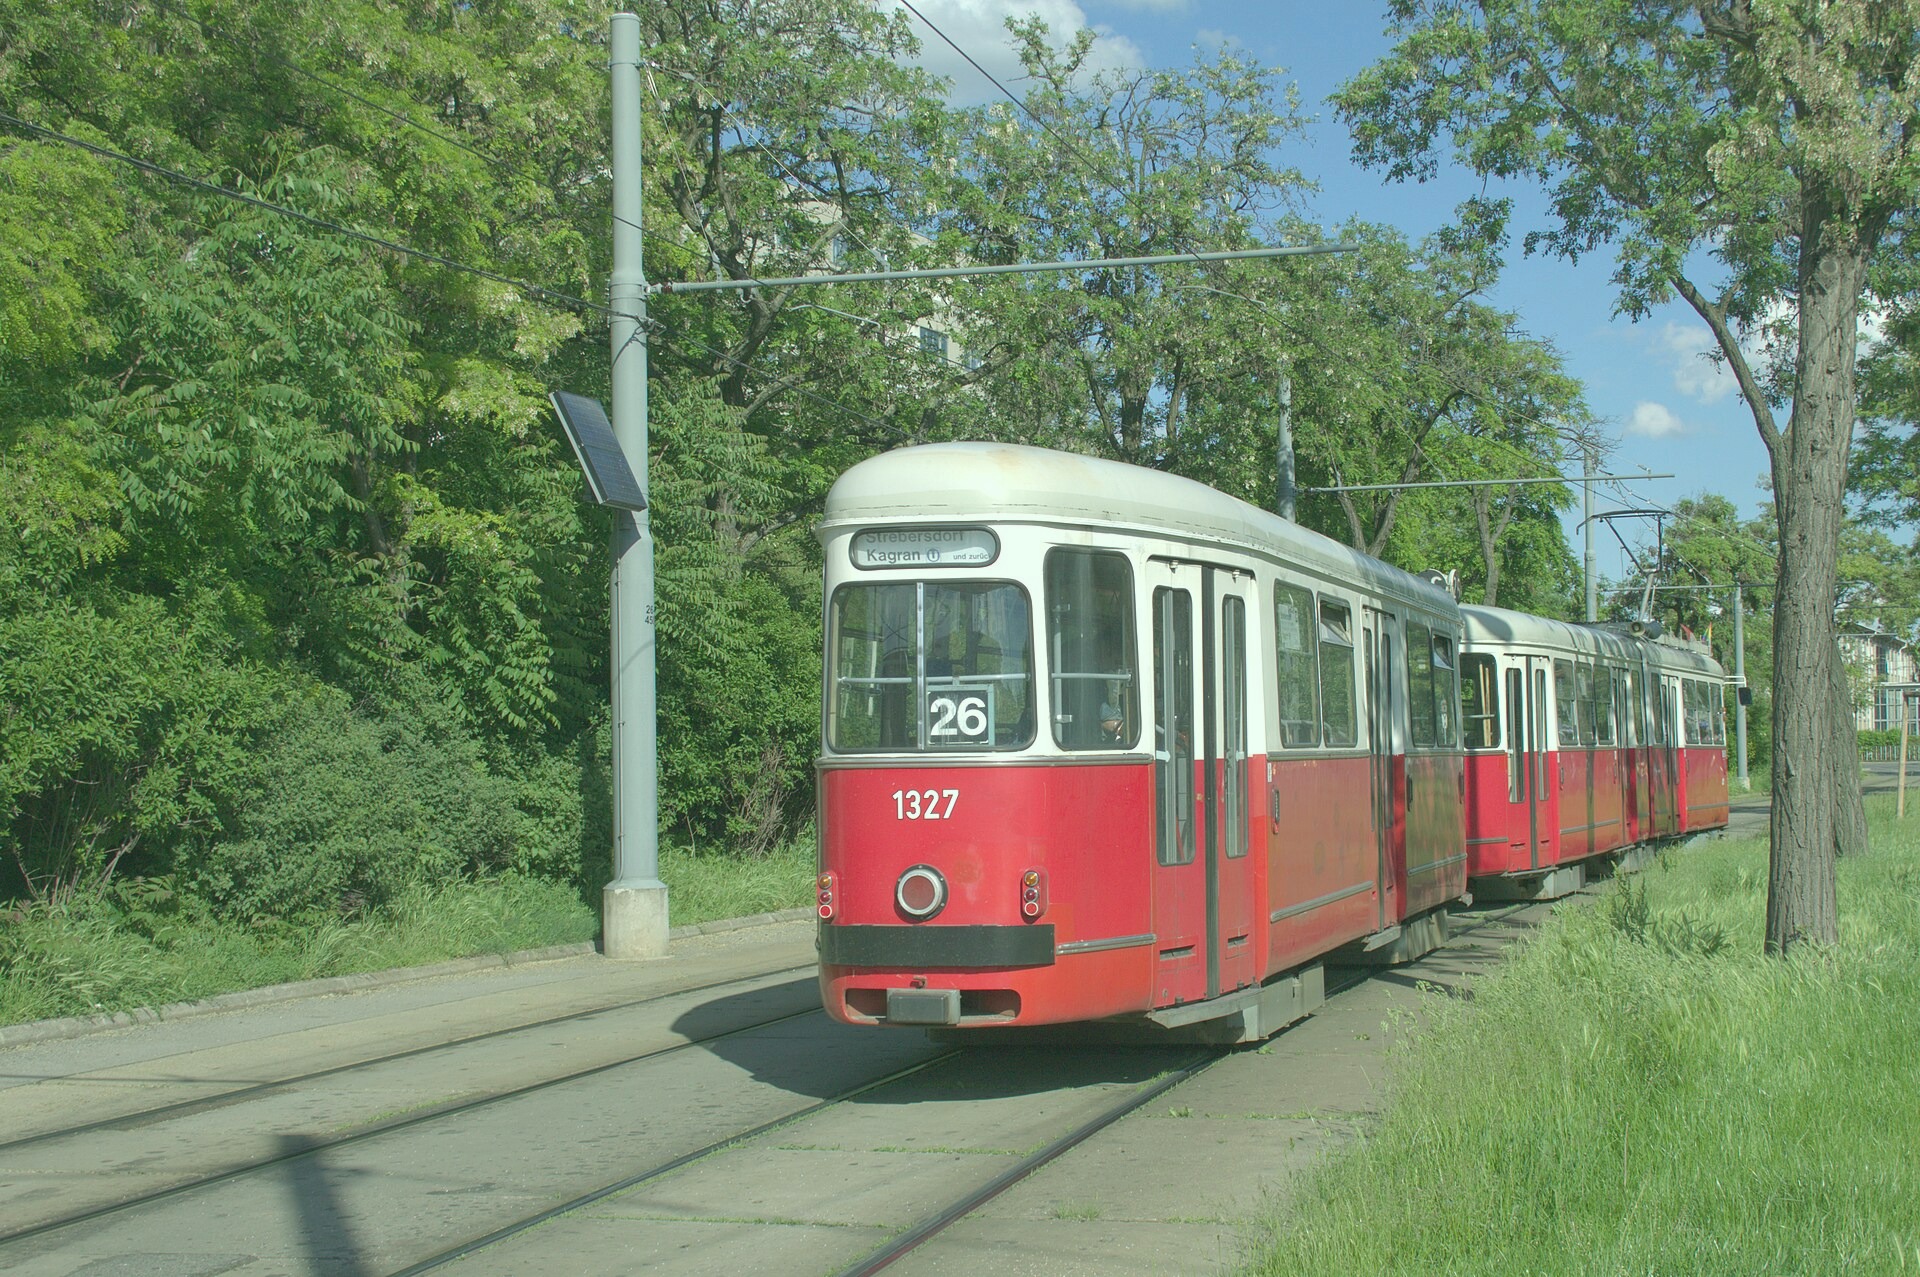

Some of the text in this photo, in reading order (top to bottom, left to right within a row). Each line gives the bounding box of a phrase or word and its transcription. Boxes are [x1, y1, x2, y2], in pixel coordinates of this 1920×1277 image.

[867, 549, 921, 563] Kagran
[930, 697, 987, 736] 26
[892, 789, 959, 820] 1327
